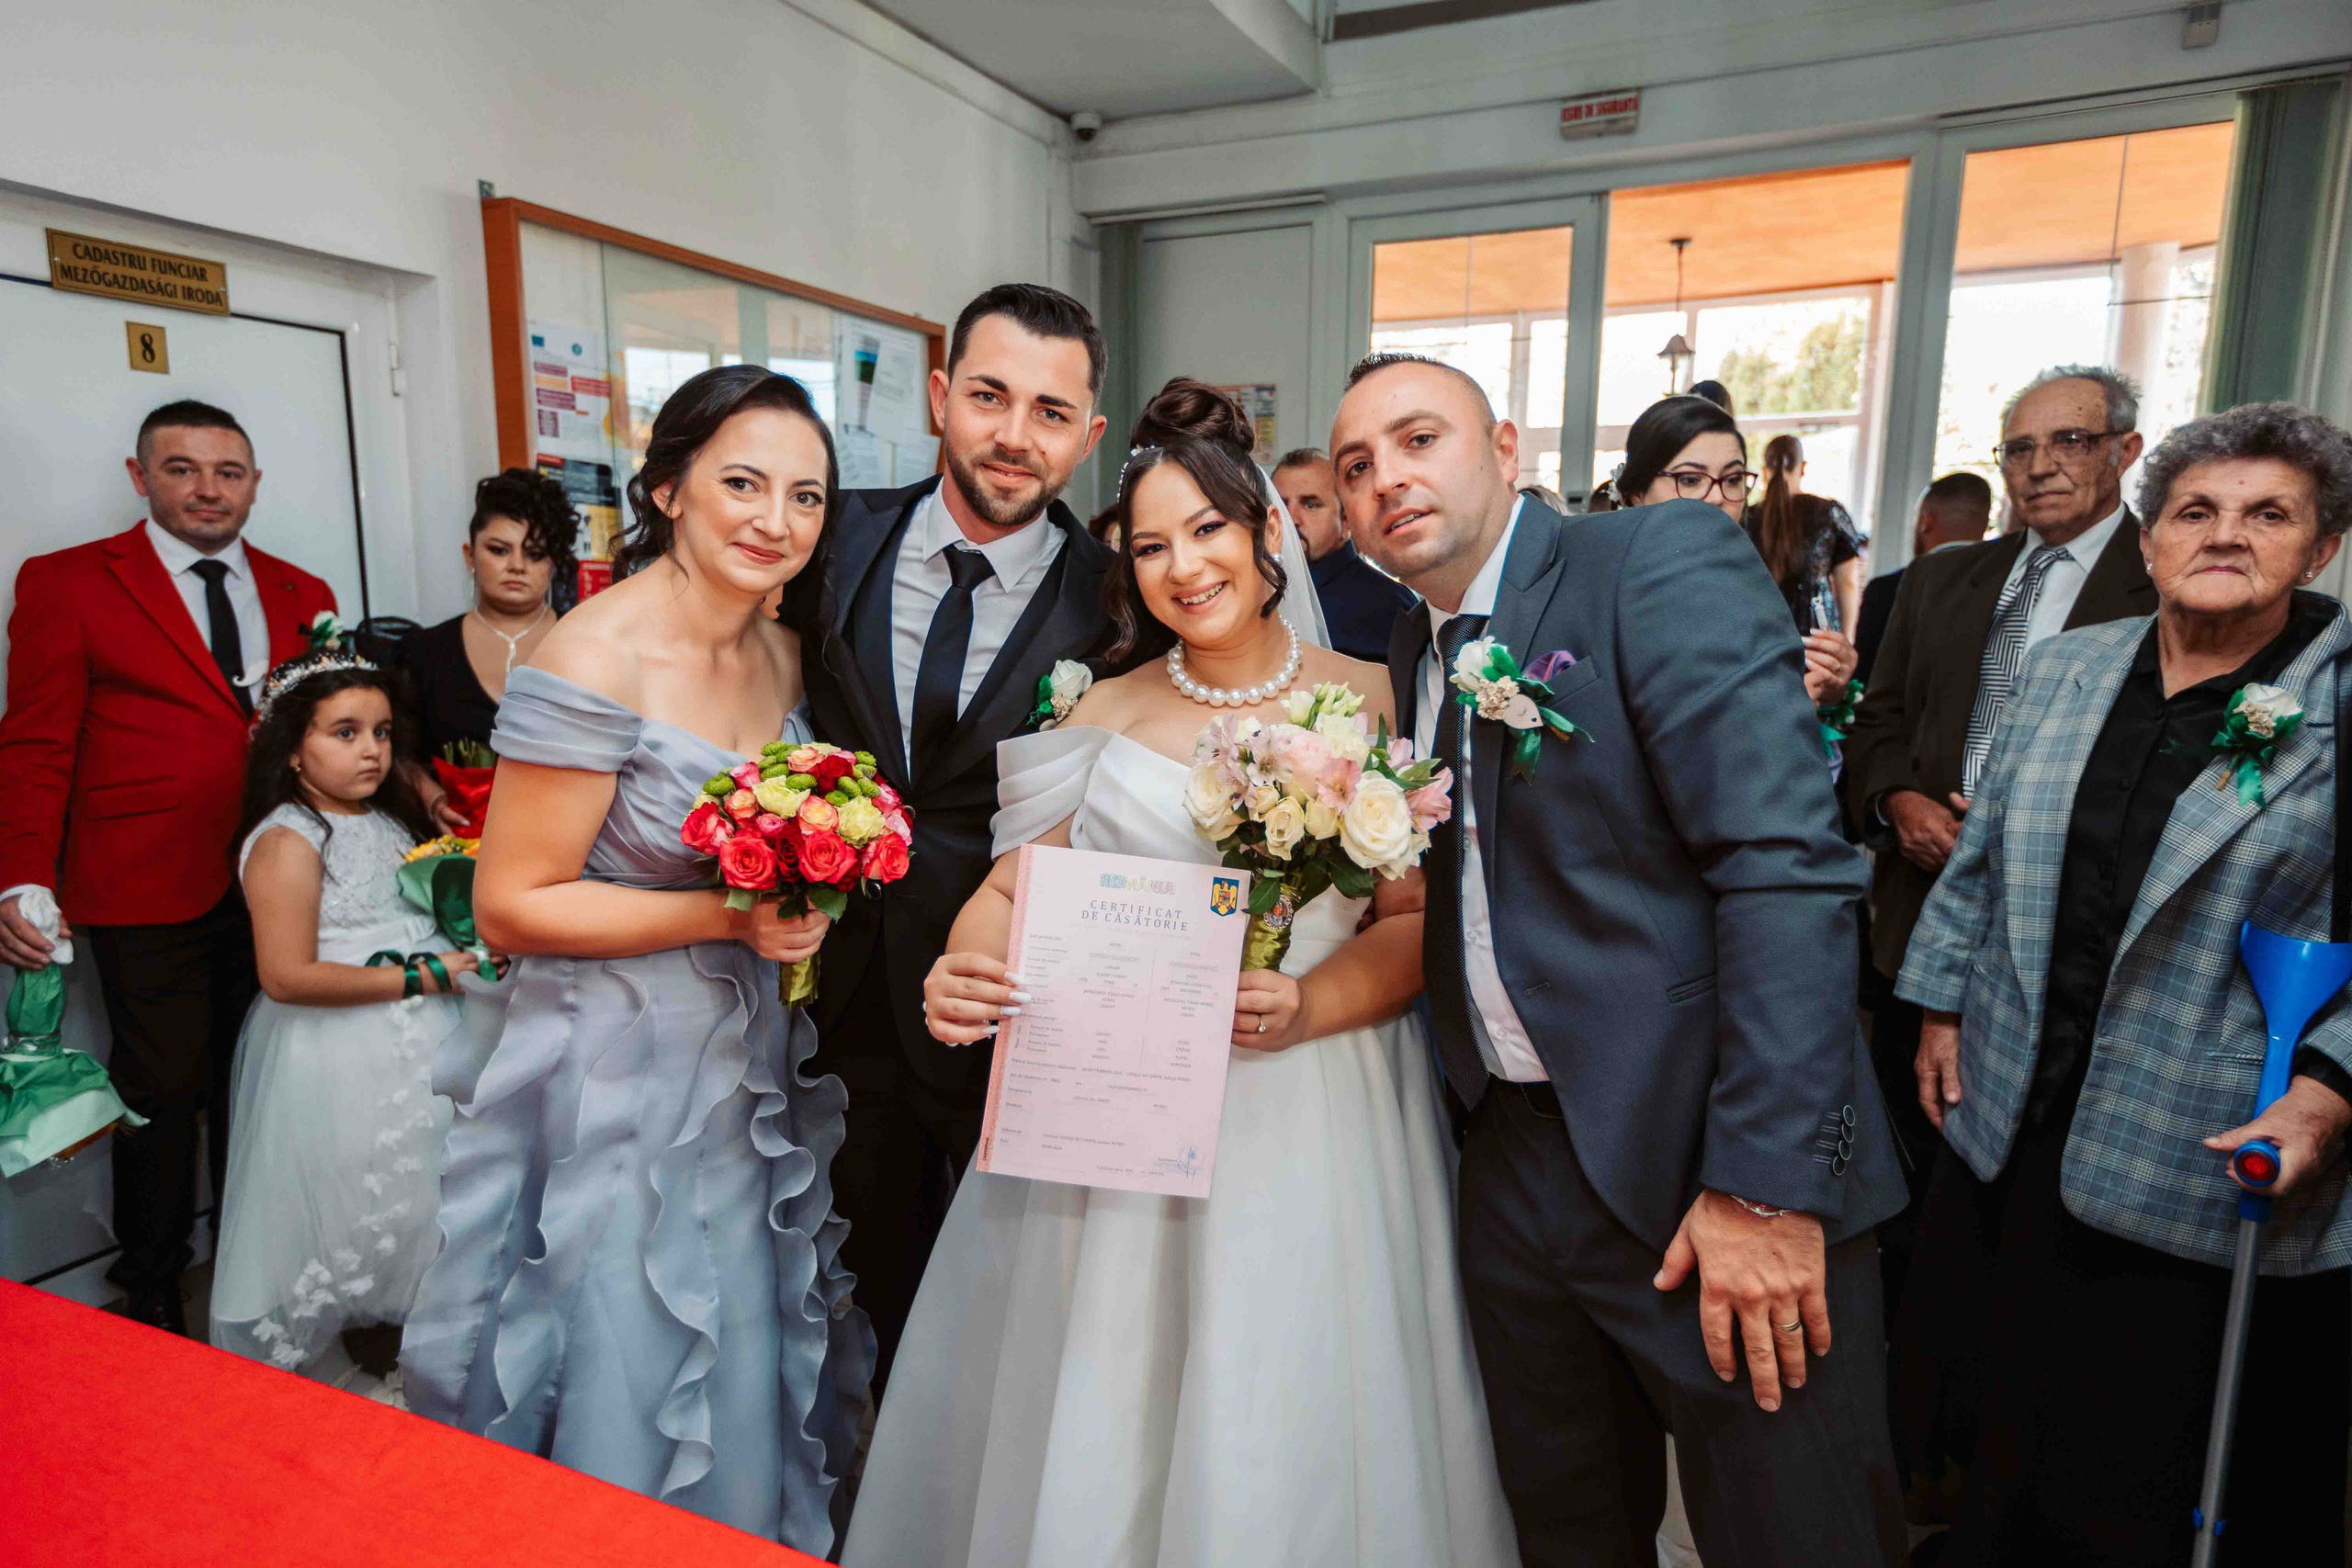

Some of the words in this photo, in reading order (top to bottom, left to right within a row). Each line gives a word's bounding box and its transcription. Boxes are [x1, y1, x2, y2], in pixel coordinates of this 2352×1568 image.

[73, 243, 147, 271] CADASTRU
[152, 258, 209, 282] FUNCIAR
[61, 264, 178, 299] MEZŐGAZDASÁGI
[181, 286, 223, 307] IRODA
[140, 333, 155, 363] 8
[1100, 873, 1175, 896] ROMÂNIA
[1081, 909, 1099, 921] DE
[1104, 912, 1188, 931] CĂSĂTORIE
[1091, 899, 1182, 919] CERTIFICAT
